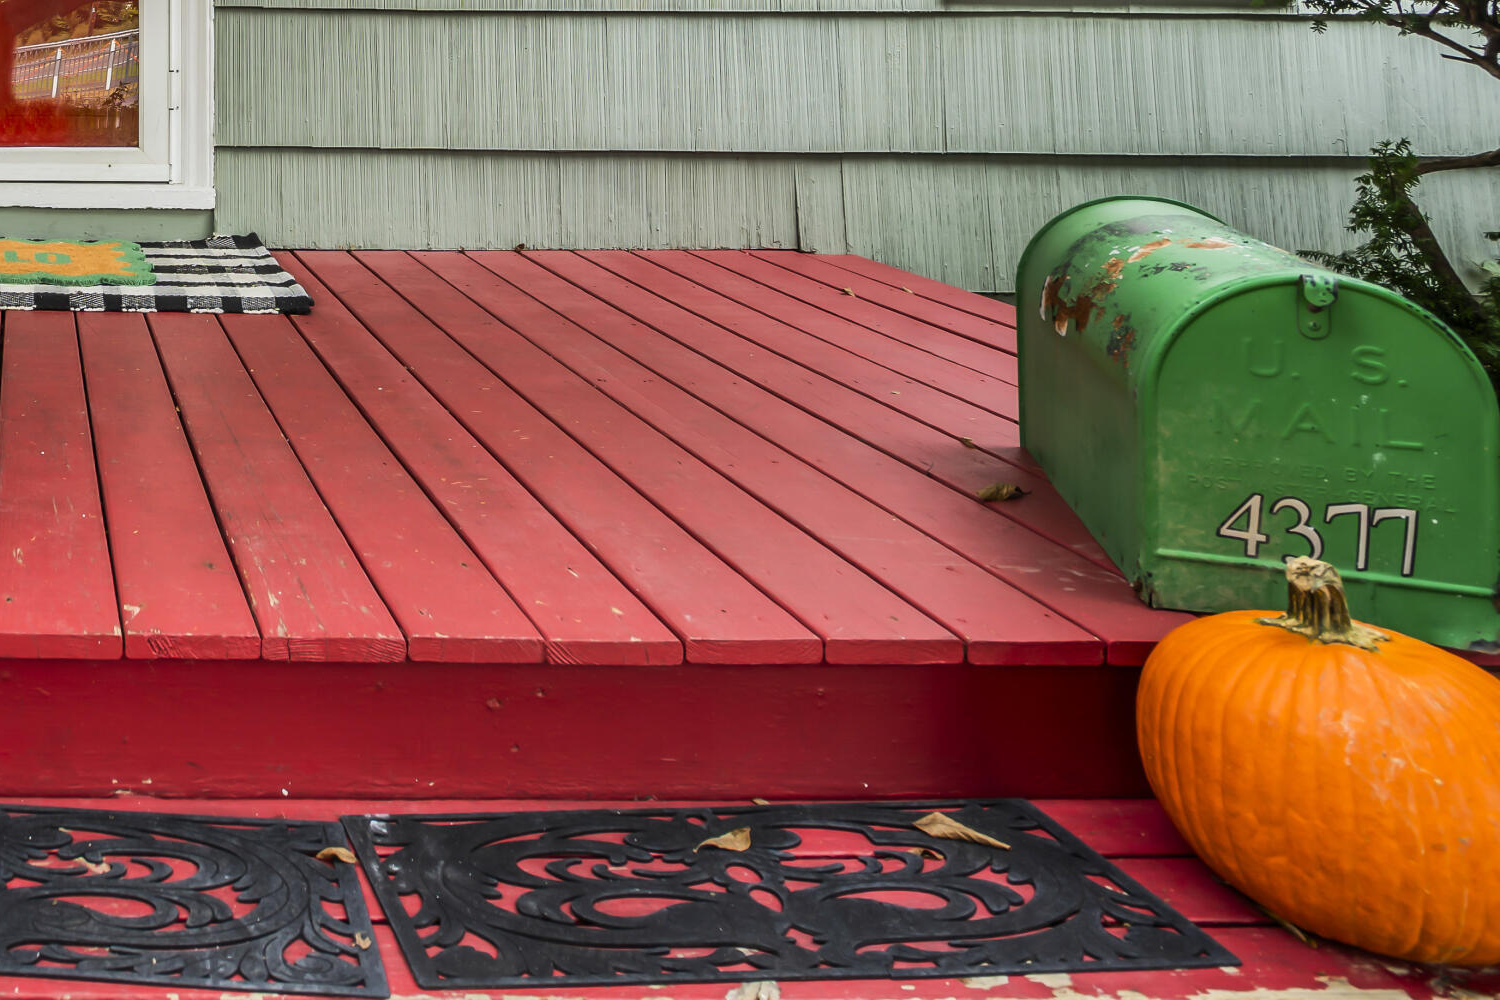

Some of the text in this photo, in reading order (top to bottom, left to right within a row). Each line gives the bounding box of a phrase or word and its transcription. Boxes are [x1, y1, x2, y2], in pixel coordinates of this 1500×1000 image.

[1350, 343, 1410, 389] S.
[1213, 397, 1426, 453] MAIL
[1342, 465, 1376, 484] BY
[1387, 470, 1437, 491] THE
[1216, 493, 1419, 578] 4377
